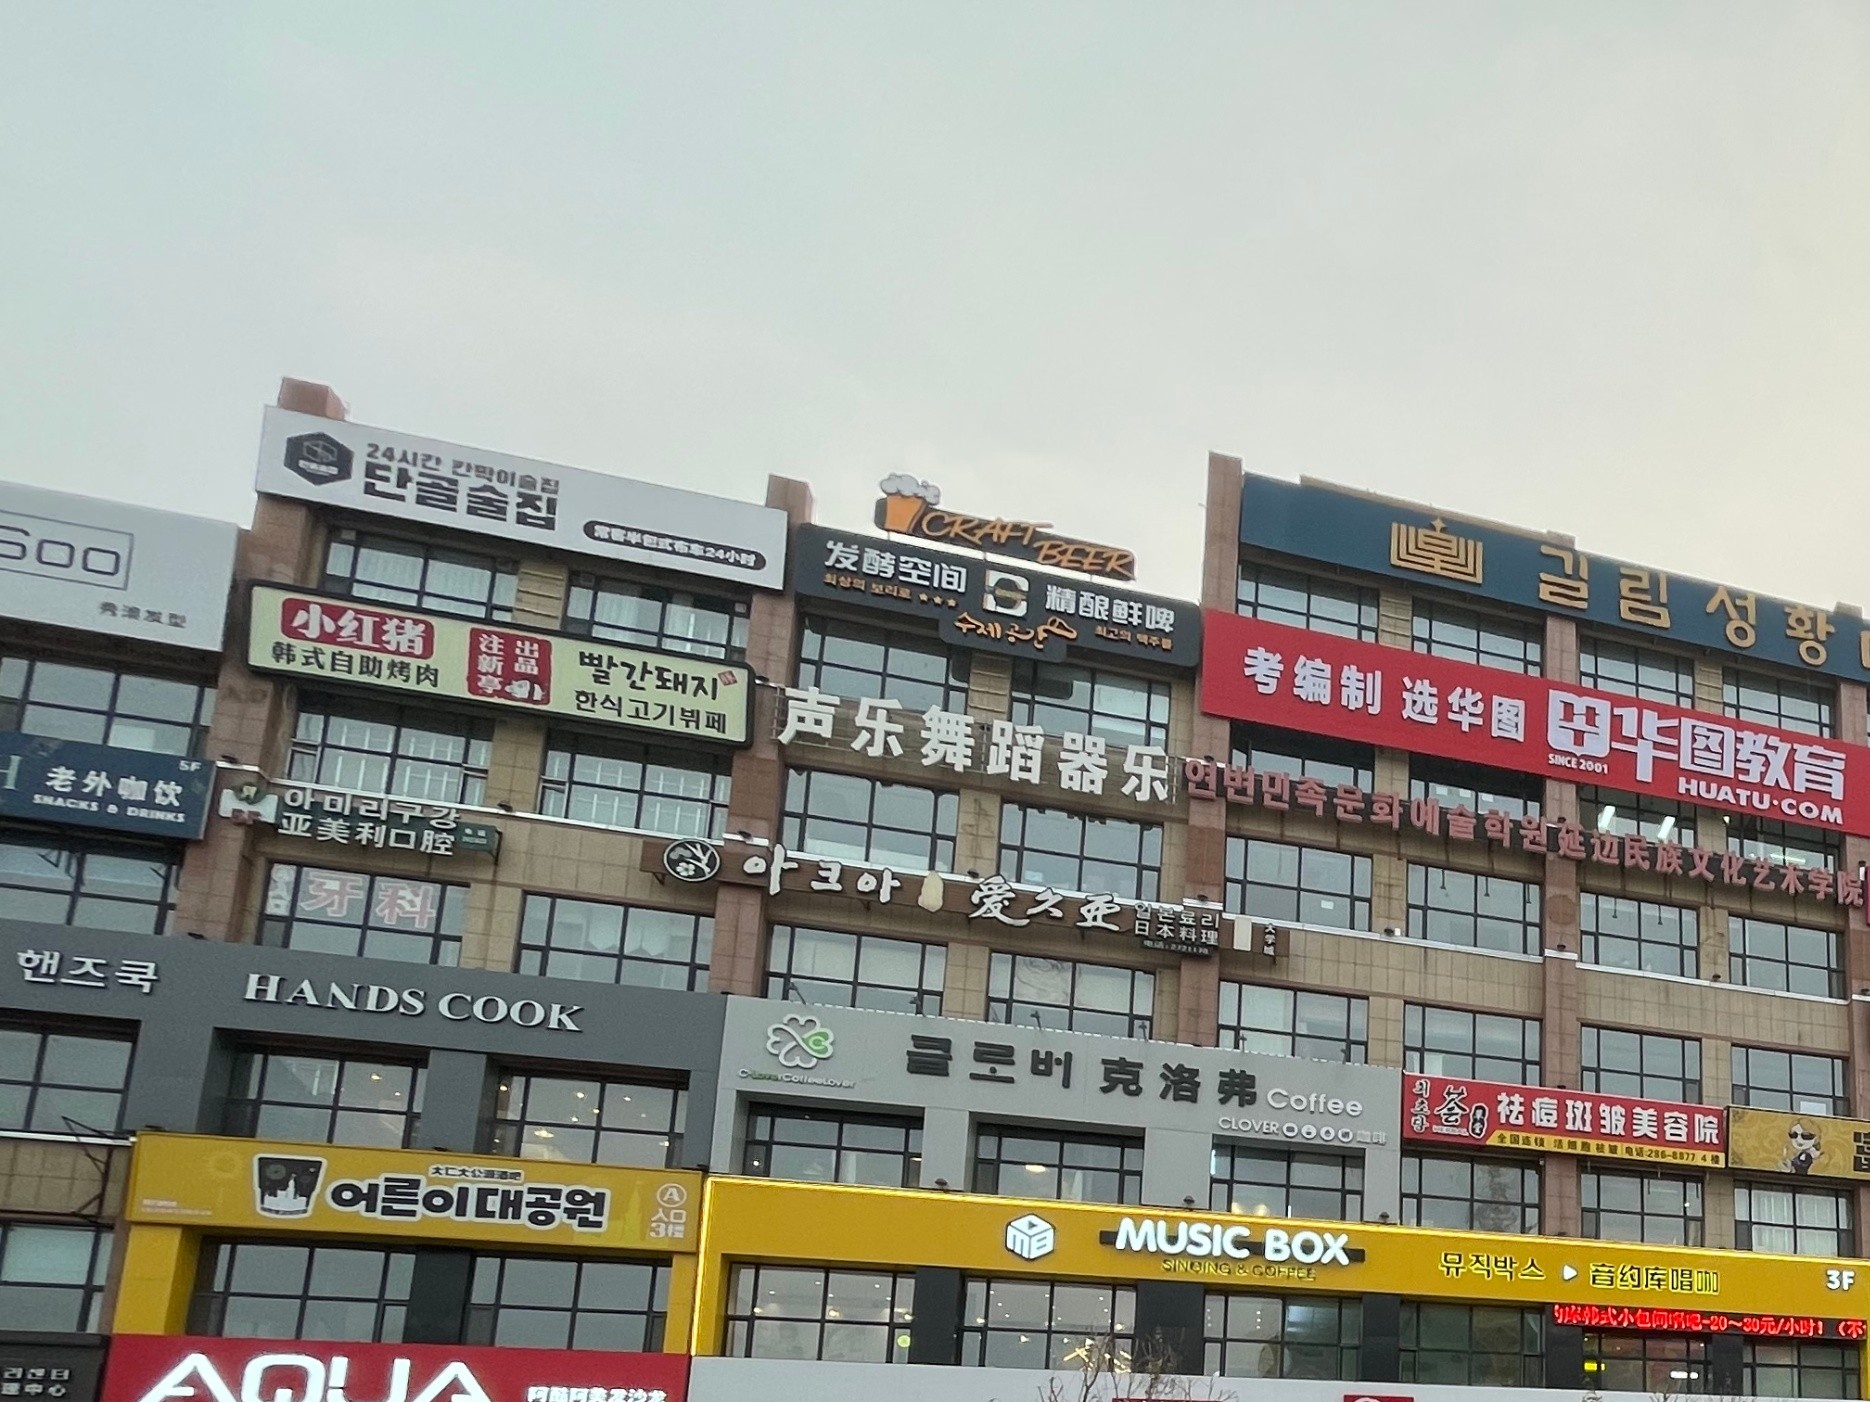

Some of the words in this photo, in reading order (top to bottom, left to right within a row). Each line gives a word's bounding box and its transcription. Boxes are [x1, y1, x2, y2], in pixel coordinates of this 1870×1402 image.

[363, 459, 559, 530] 단골술집
[823, 539, 967, 593] 发酵空间
[920, 513, 1053, 546] CRAFT
[1033, 540, 1135, 577] BEER
[291, 605, 426, 657] 小红猪
[1045, 584, 1176, 635] 精酿鲜啤
[271, 641, 439, 688] 韩式自助烤肉
[514, 640, 540, 675] 出品
[579, 651, 720, 700] 빨간돼지
[574, 689, 727, 734] 한식고기뷔페
[1243, 646, 1383, 715] 考编制
[1401, 676, 1526, 743] 选华图
[179, 760, 202, 772] 5F
[777, 685, 1168, 802] 声乐舞蹈器乐
[1548, 753, 1578, 770] SINCE
[1579, 758, 1609, 775] 2001
[1612, 706, 1846, 801] 华图教育
[33, 793, 100, 812] SNACKS
[126, 806, 186, 823] DRINKS
[44, 765, 183, 807] 老外咖饮
[284, 788, 461, 829] 아미리구강
[1185, 757, 1549, 854] 연변민족문화예술학원
[1678, 776, 1844, 824] HUATU·COM
[278, 813, 456, 857] 亚美利口腔
[1557, 822, 1864, 908] 延边民族文化艺术学院
[301, 868, 437, 931] 牙科
[1134, 901, 1220, 929] 일본료리
[1134, 919, 1219, 946] 日本料理
[16, 948, 160, 993] 핸즈쿡
[244, 972, 426, 1017] HANDS
[437, 992, 585, 1033] COOK
[905, 1033, 1073, 1089] 글로버
[1099, 1056, 1258, 1108] 克洛弗
[1217, 1116, 1280, 1136] CLOVER
[1266, 1087, 1363, 1117] Coffee
[1497, 1092, 1720, 1146] 祛痘斑皱美容院
[331, 1176, 606, 1230] 어른이대공원
[1115, 1217, 1251, 1260] MUSIC
[1264, 1227, 1351, 1266] BOX
[1438, 1250, 1547, 1282] 뮤직박스
[1826, 1269, 1856, 1291] 3F
